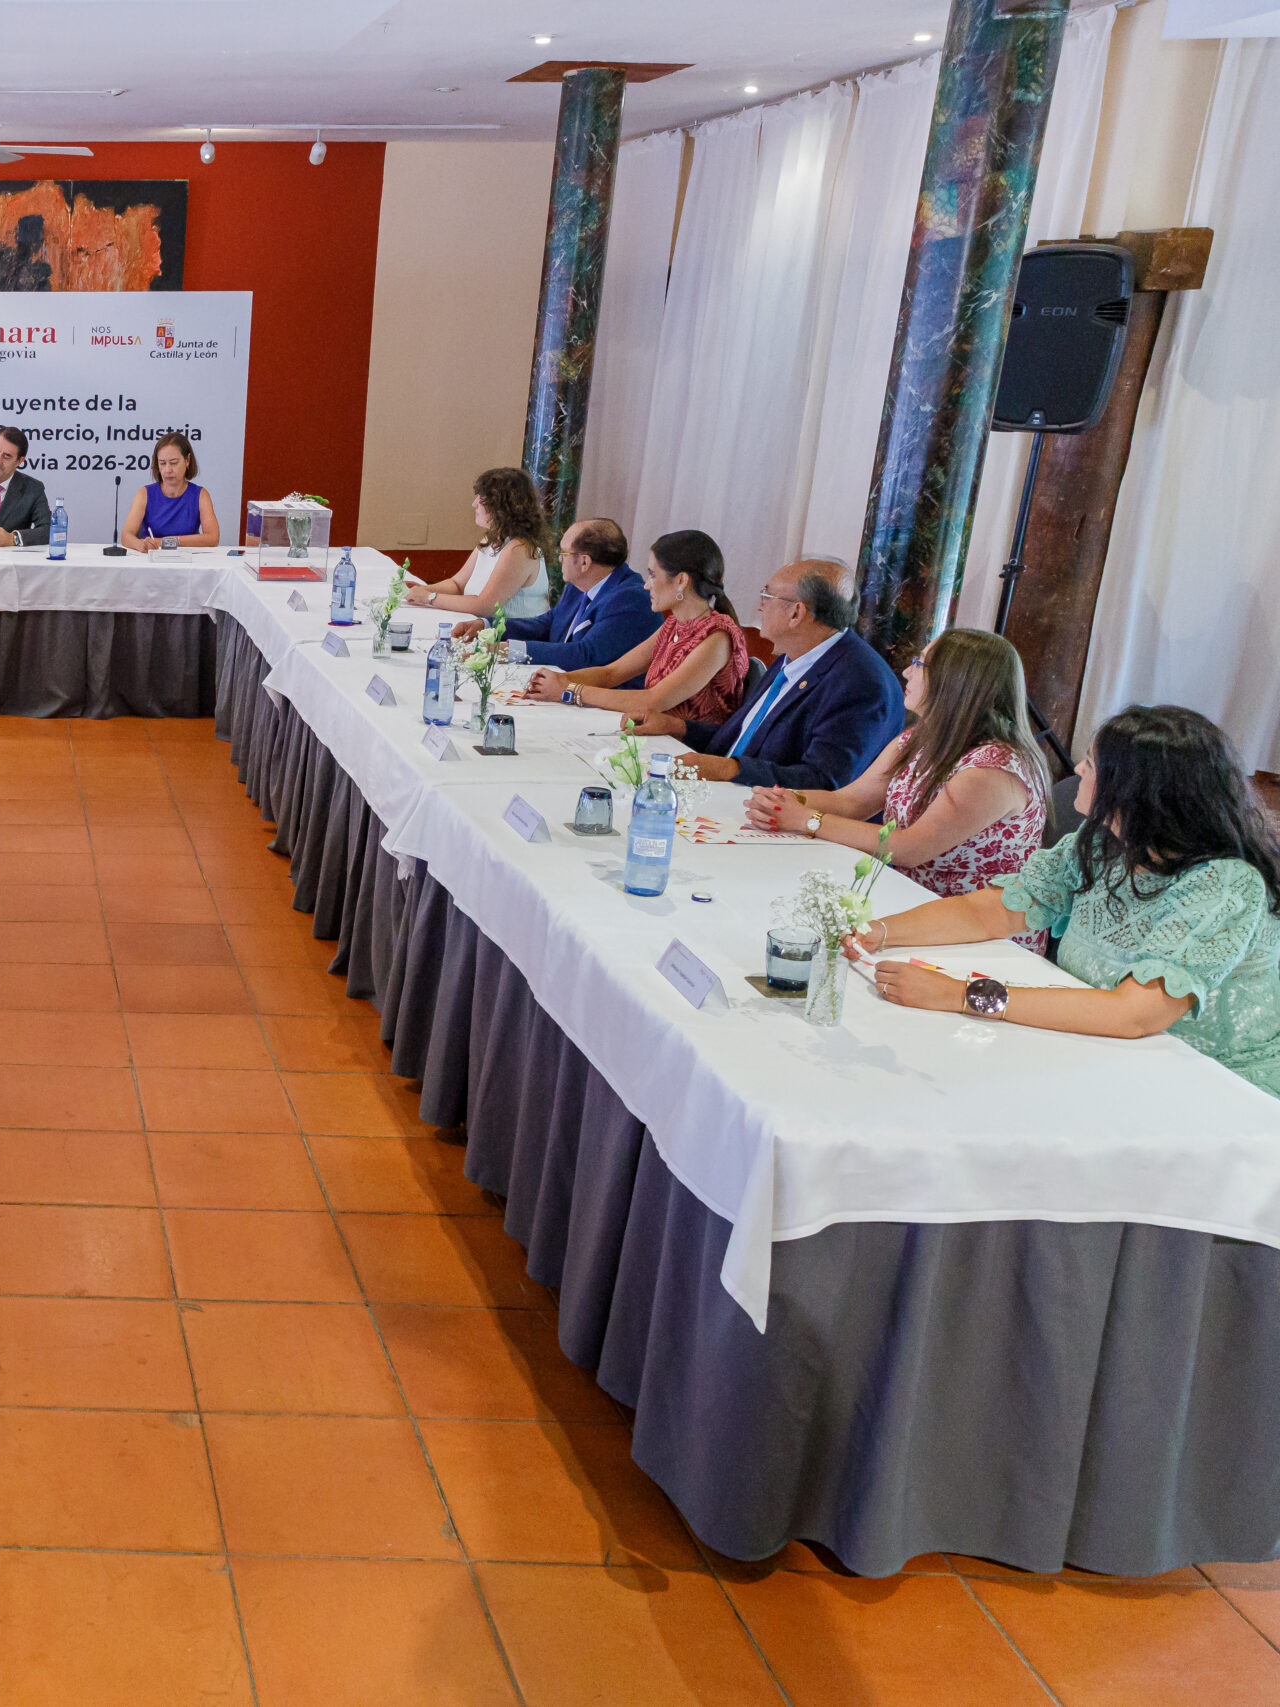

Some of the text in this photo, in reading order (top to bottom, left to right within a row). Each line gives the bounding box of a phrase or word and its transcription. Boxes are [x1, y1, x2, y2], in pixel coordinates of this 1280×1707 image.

[1041, 306, 1078, 316] EON
[91, 326, 111, 334] NOS
[176, 340, 218, 349] Junta de
[149, 349, 218, 360] Castilla y León
[85, 394, 113, 411] de
[118, 394, 137, 411] la
[65, 454, 153, 471] 2026-20
